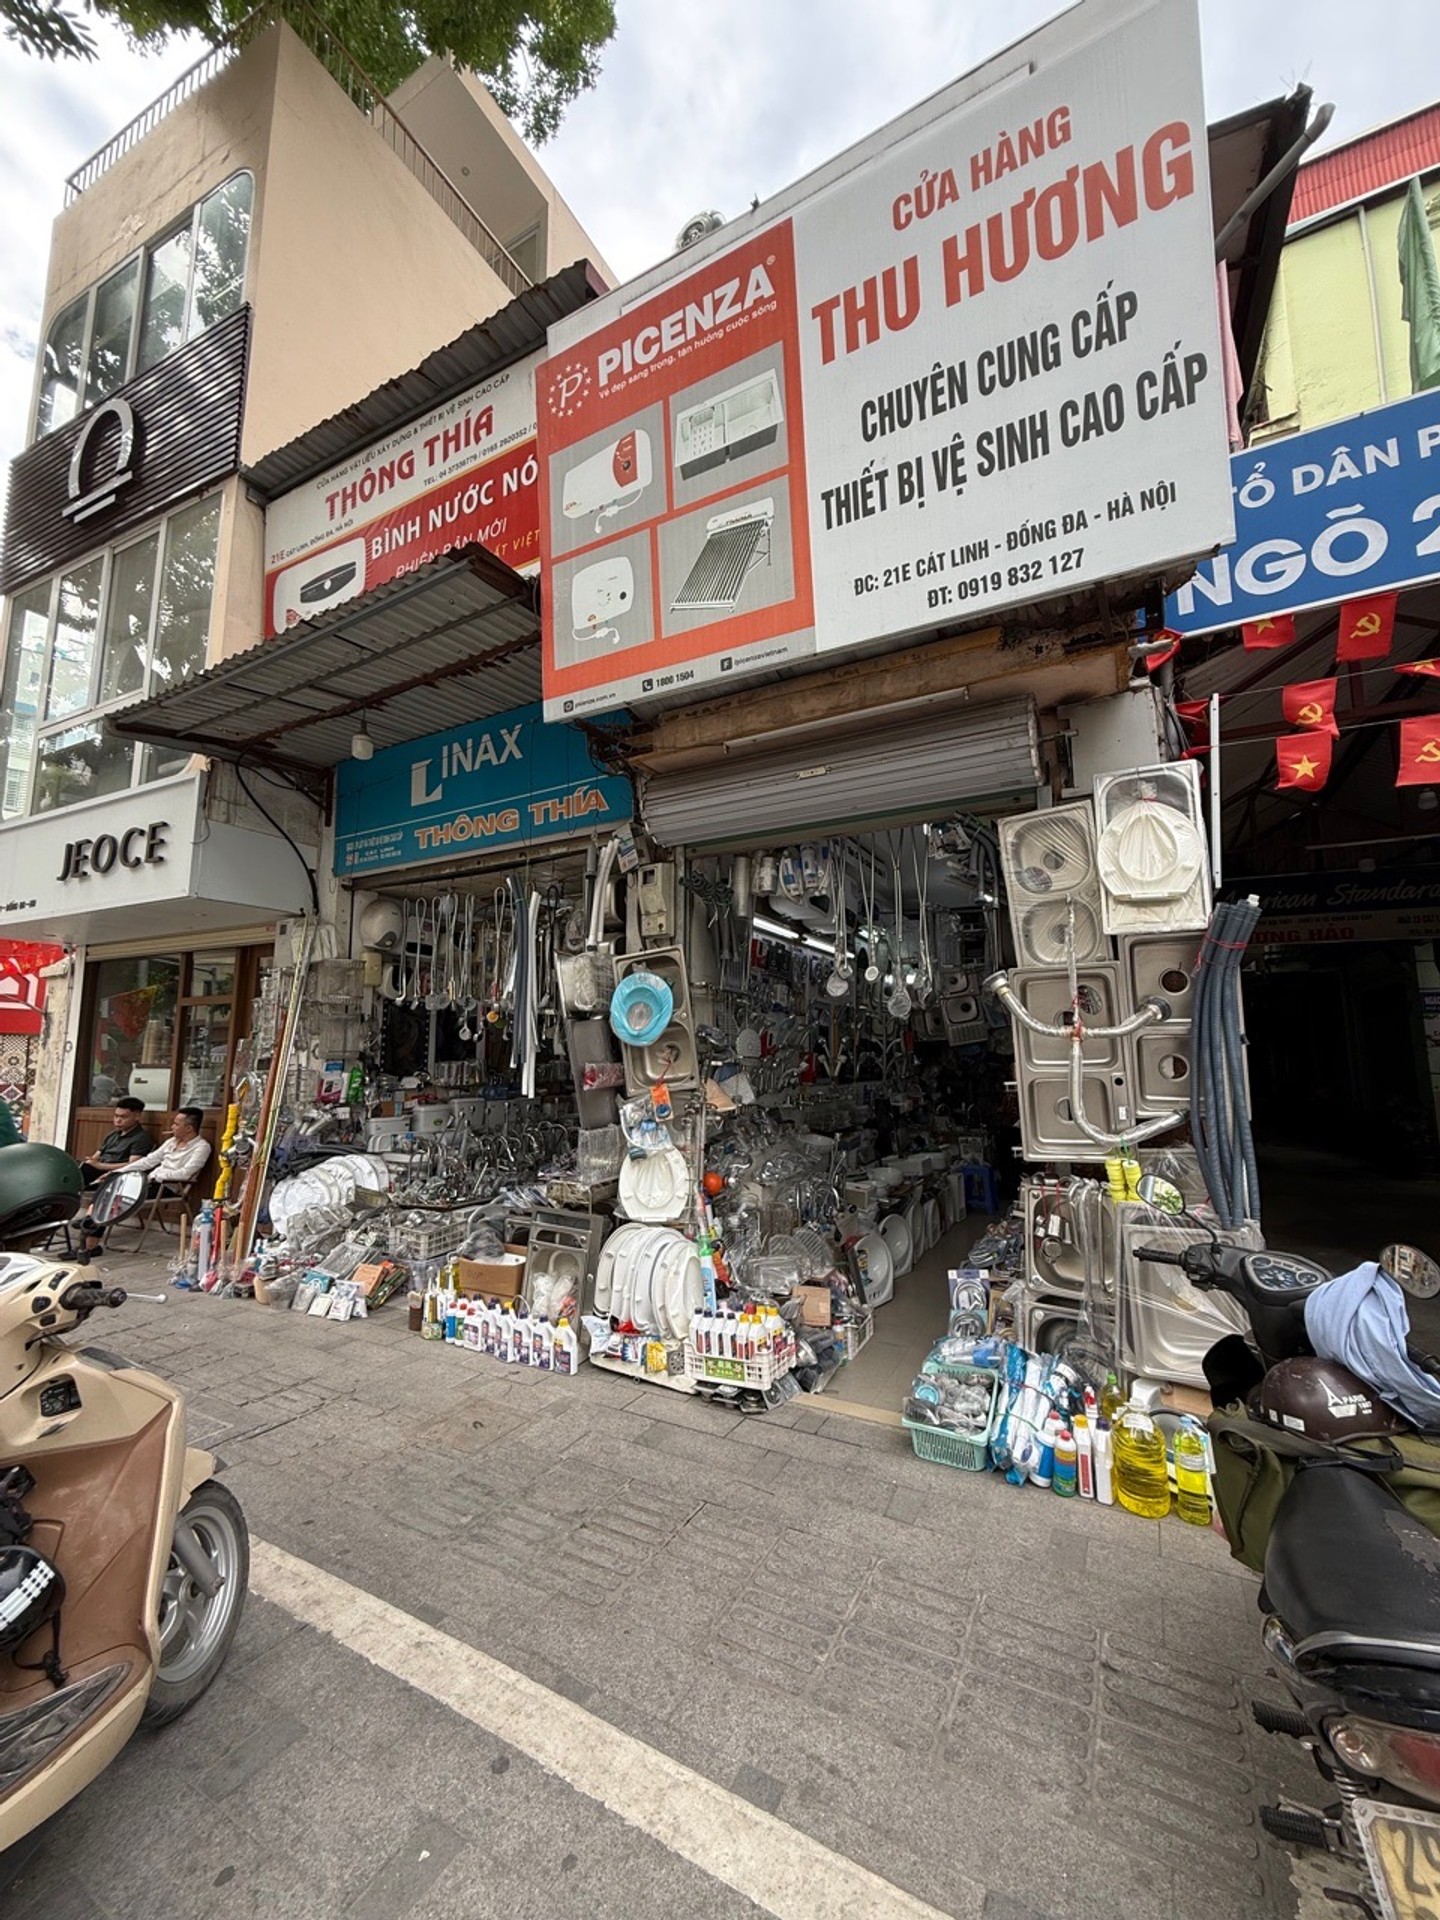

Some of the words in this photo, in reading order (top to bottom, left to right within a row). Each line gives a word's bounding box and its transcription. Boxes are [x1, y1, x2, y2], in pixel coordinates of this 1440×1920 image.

[892, 170, 959, 231] CỬA
[970, 105, 1072, 192] HÀNG
[811, 254, 920, 365] THU
[942, 121, 1195, 308] HƯƠNG
[598, 264, 775, 387] PICENZA
[628, 368, 649, 385] sang
[725, 315, 749, 332] cuộc
[751, 300, 777, 319] sống
[861, 362, 967, 442] CHUYÊN
[977, 323, 1061, 396] CUNG
[1072, 280, 1138, 358] CẤP
[457, 394, 474, 409] SINH
[475, 384, 492, 400] CAO
[821, 459, 889, 530] THIẾT
[898, 458, 925, 513] BỊ
[932, 433, 967, 496] VỆ
[976, 410, 1048, 477] SINH
[1060, 382, 1124, 447] CAO
[1136, 340, 1209, 421] CẤP
[325, 449, 414, 521] THÔNG
[423, 405, 494, 467] THÍA
[1232, 461, 1276, 509] Ổ
[1292, 437, 1401, 496] DÂN
[371, 516, 420, 560] BÌNH
[428, 479, 494, 532] NƯỚC
[476, 517, 508, 545] MỚI
[854, 574, 880, 597] ĐC:
[884, 565, 911, 587] 21E
[915, 550, 946, 580] CÁT
[951, 539, 989, 571] LINH
[1006, 513, 1057, 553] ĐỐNG
[1061, 508, 1088, 535] ĐA
[1106, 491, 1135, 522] HÀ
[1140, 481, 1177, 511] NỘI
[1177, 503, 1389, 616] NGÕ
[927, 585, 953, 609] ĐT:
[957, 571, 1001, 601] 0919
[1007, 559, 1044, 587] 832
[1049, 549, 1085, 578] 127
[656, 675, 674, 688] 1800
[676, 670, 694, 683] 1504
[56, 820, 169, 882] JEOCE
[414, 809, 519, 850] THÔNG
[529, 785, 609, 826] THÍA
